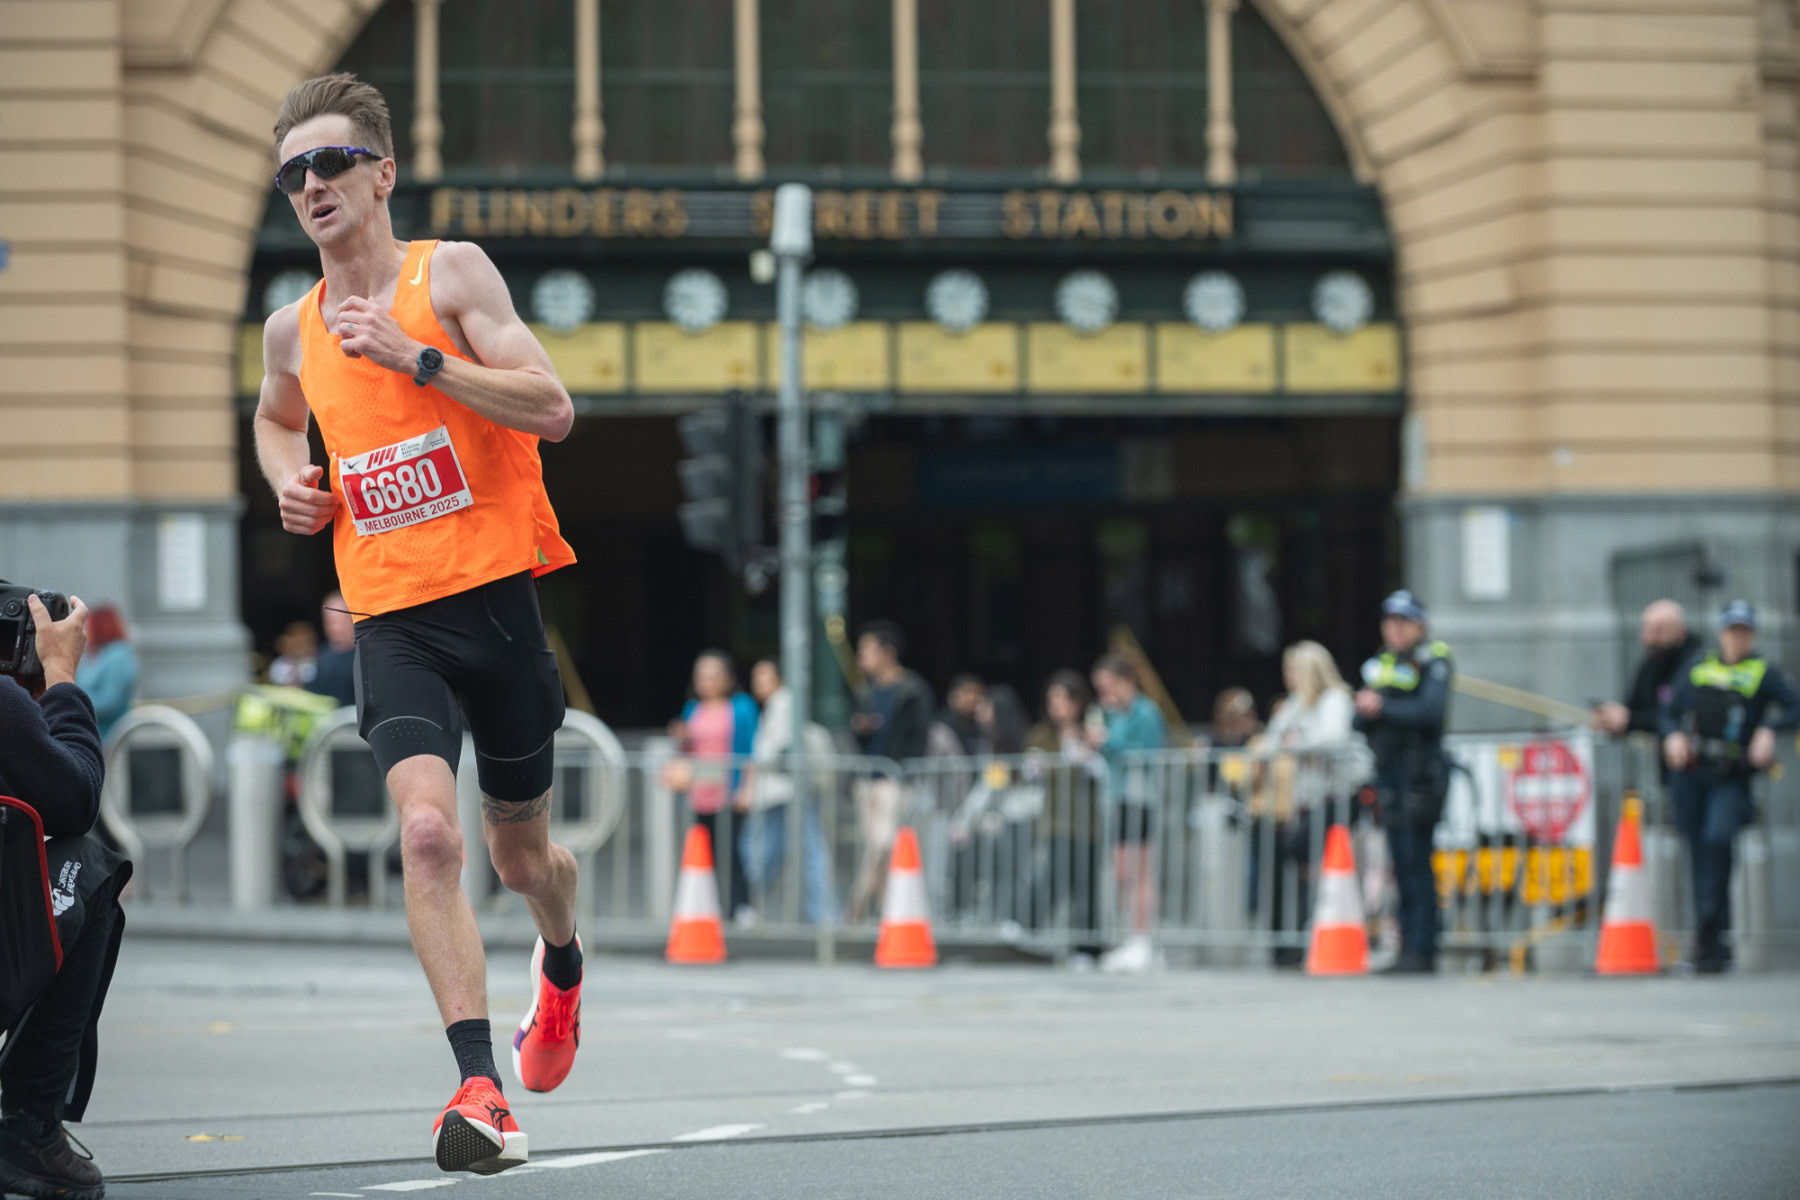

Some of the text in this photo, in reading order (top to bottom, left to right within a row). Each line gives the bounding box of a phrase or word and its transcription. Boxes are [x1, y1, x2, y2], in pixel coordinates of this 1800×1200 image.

[431, 187, 1235, 240] FLINDERS SREET STATION
[361, 458, 442, 514] 6680
[364, 496, 460, 532] MELBOURNE 2025
